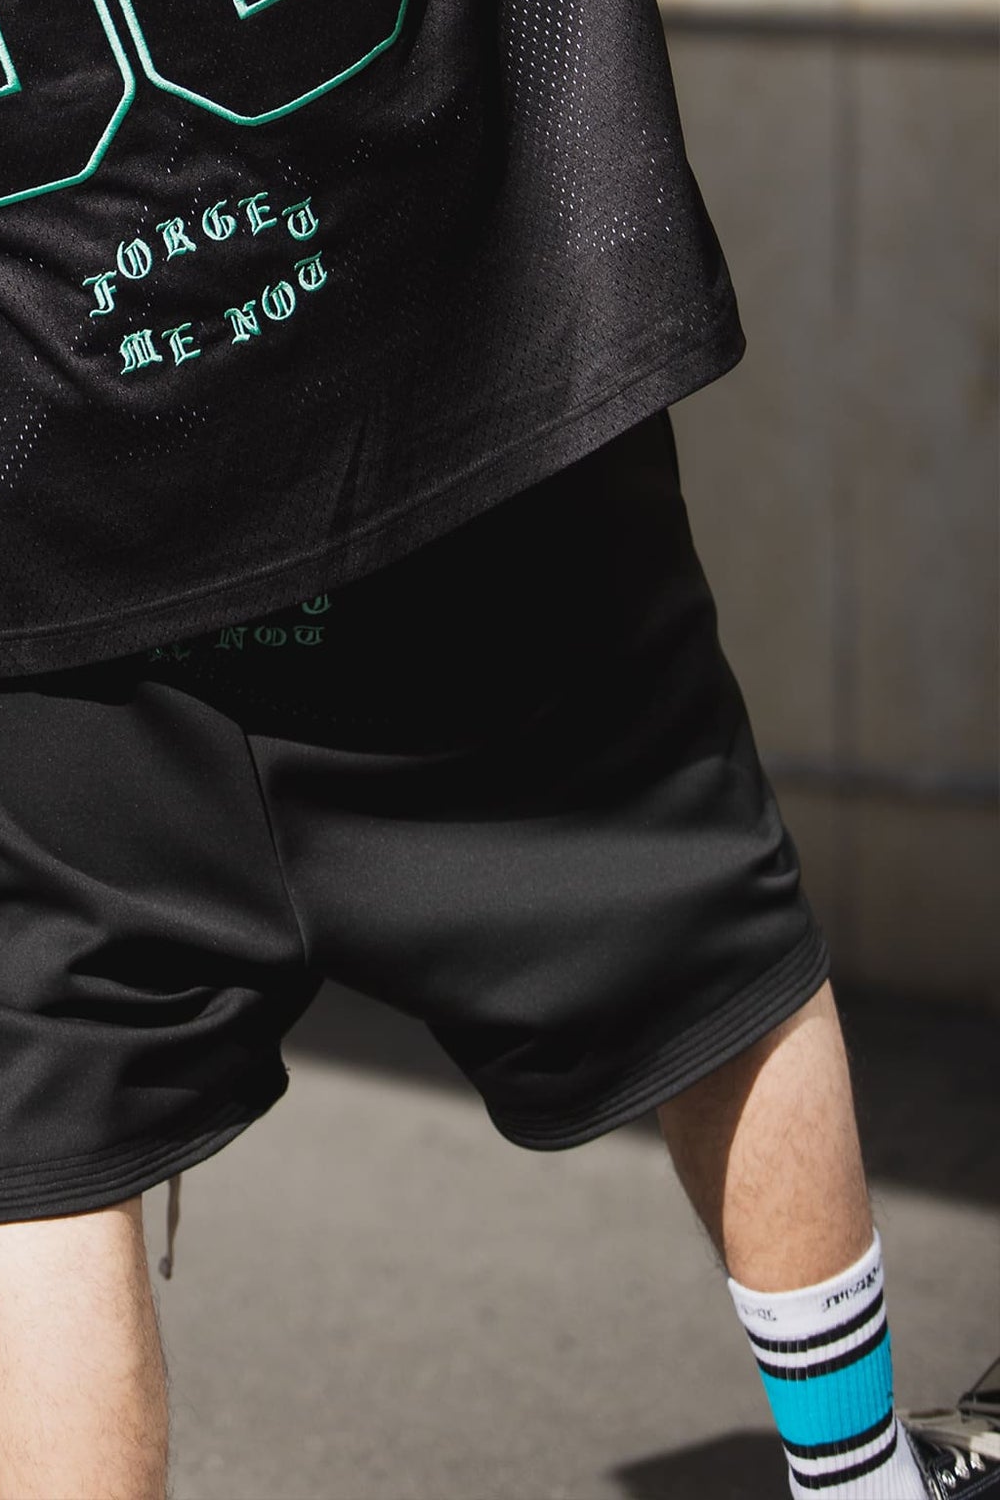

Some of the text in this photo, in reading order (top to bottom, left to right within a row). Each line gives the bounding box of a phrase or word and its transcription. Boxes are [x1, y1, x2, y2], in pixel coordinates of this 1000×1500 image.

[81, 191, 320, 318] FORGET
[118, 250, 329, 376] ME NOT
[213, 625, 326, 651] NOT
